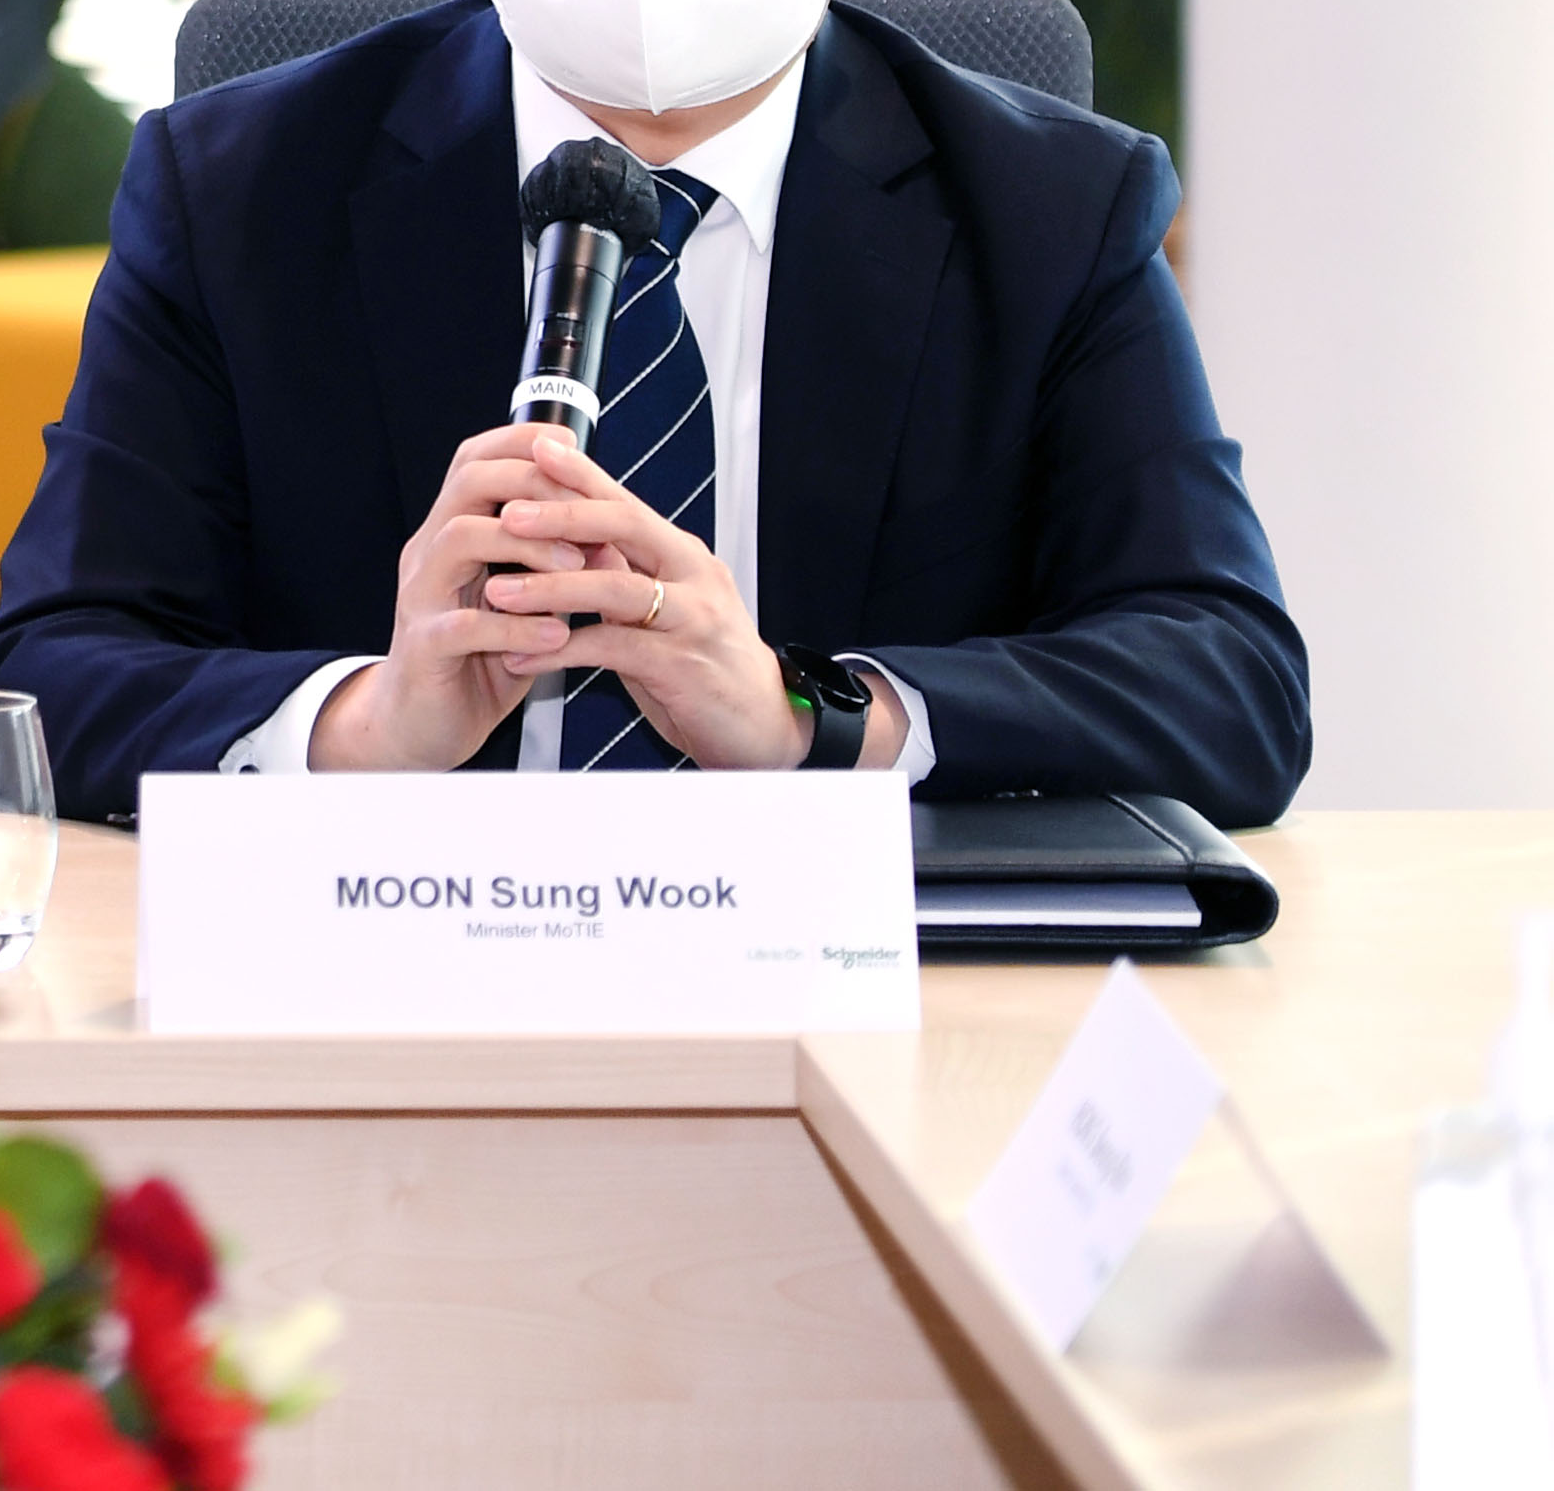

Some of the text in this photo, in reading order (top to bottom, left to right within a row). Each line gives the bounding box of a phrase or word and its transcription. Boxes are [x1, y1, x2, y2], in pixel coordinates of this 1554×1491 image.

[528, 381, 574, 398] MAIN
[336, 876, 737, 918] MOON Sung Wook
[466, 922, 604, 938] Minister MoTIE
[821, 946, 901, 969] Schneider
